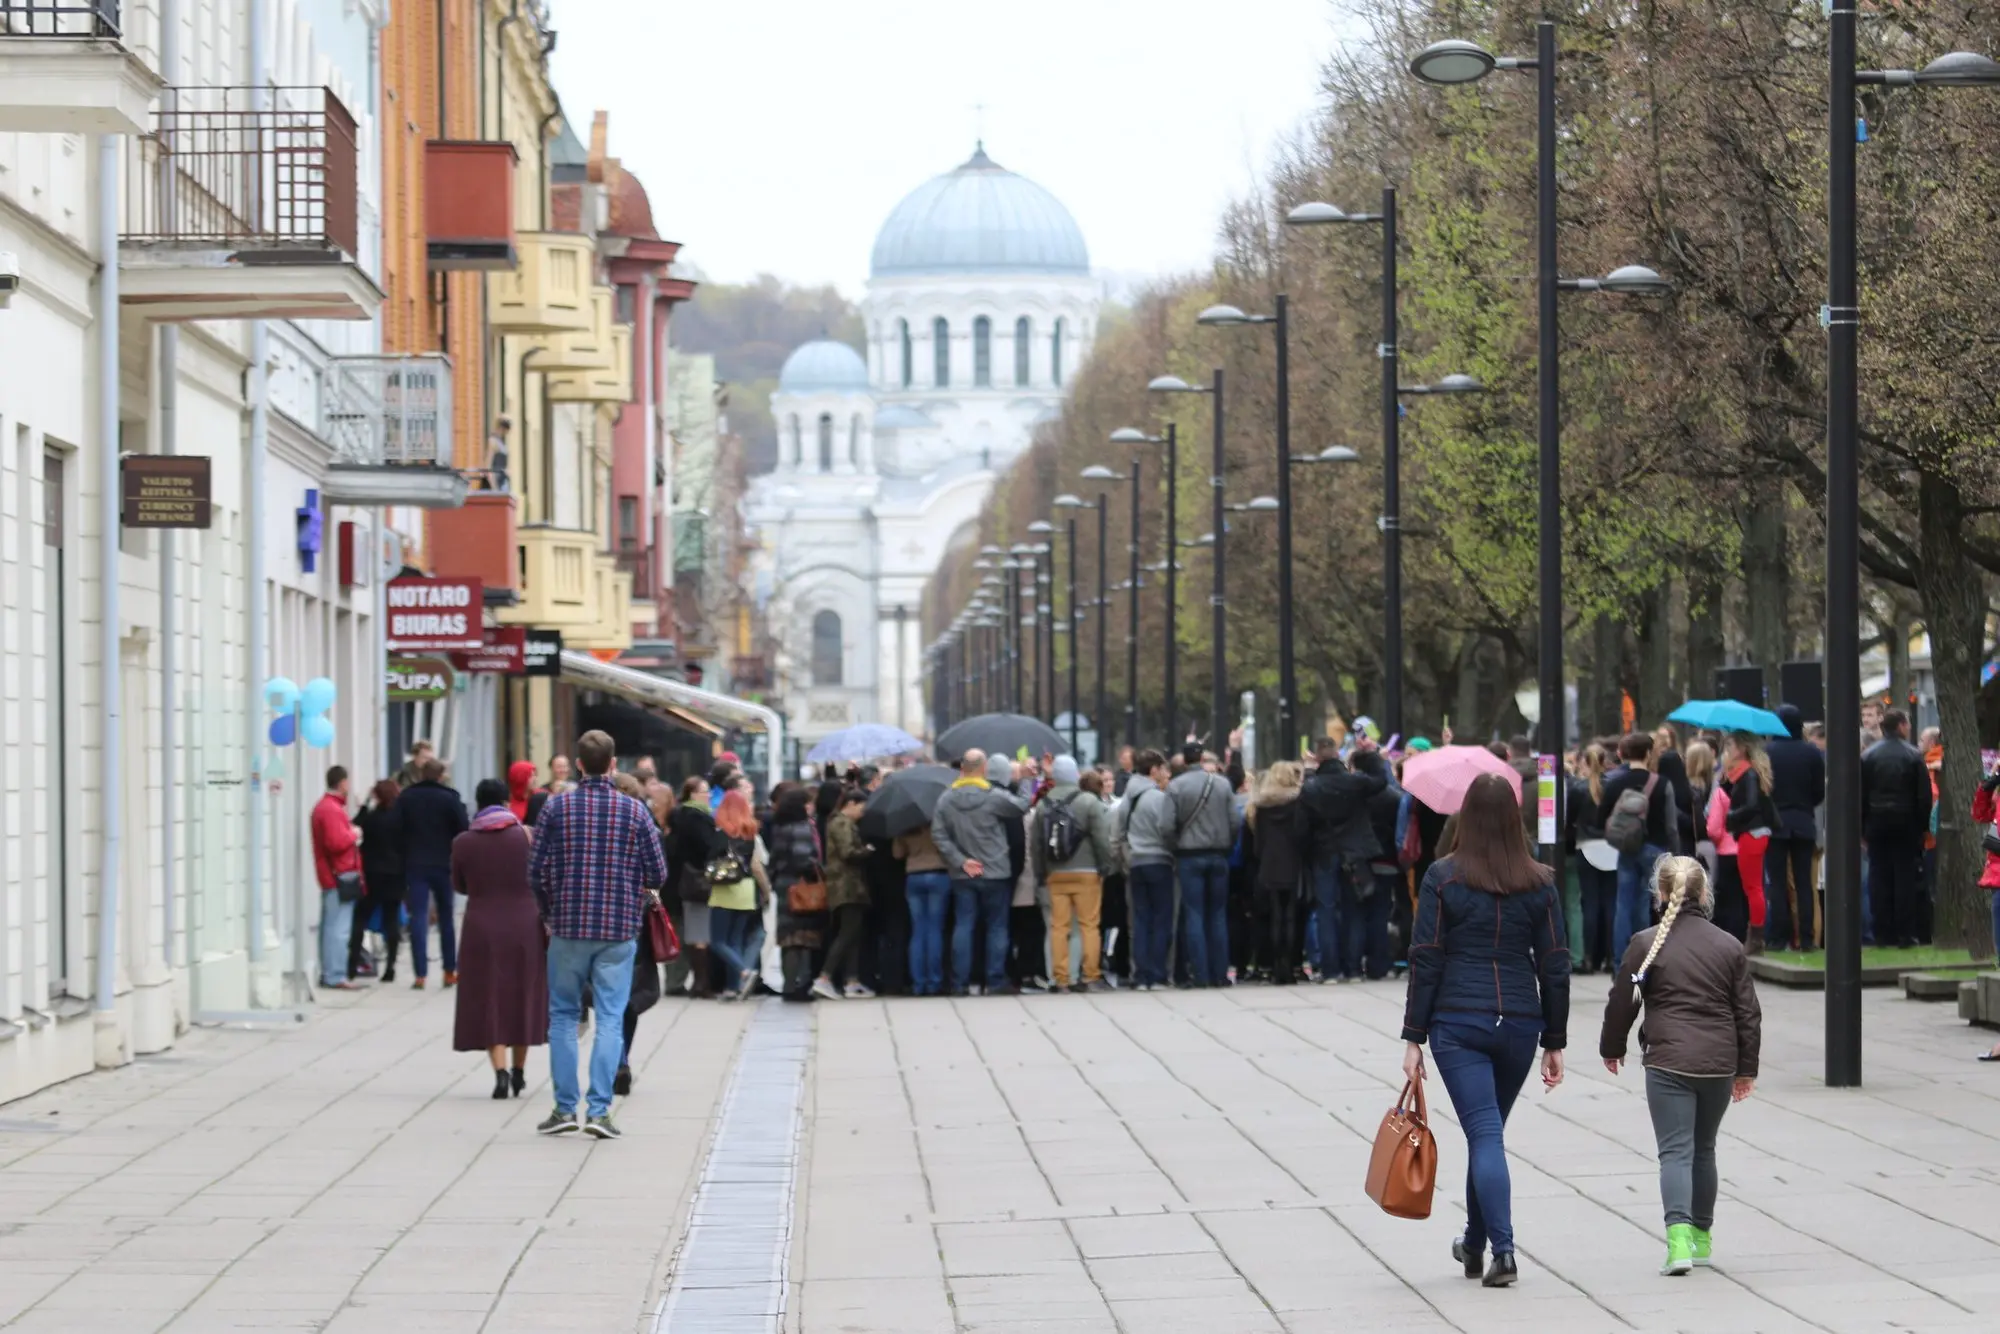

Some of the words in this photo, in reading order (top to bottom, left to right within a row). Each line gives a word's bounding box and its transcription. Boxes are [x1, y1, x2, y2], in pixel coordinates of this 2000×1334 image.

[138, 502, 195, 511] CURRENCY
[138, 512, 195, 522] EXCHANGE
[388, 585, 470, 607] NOTARO
[392, 613, 468, 635] BIURAS
